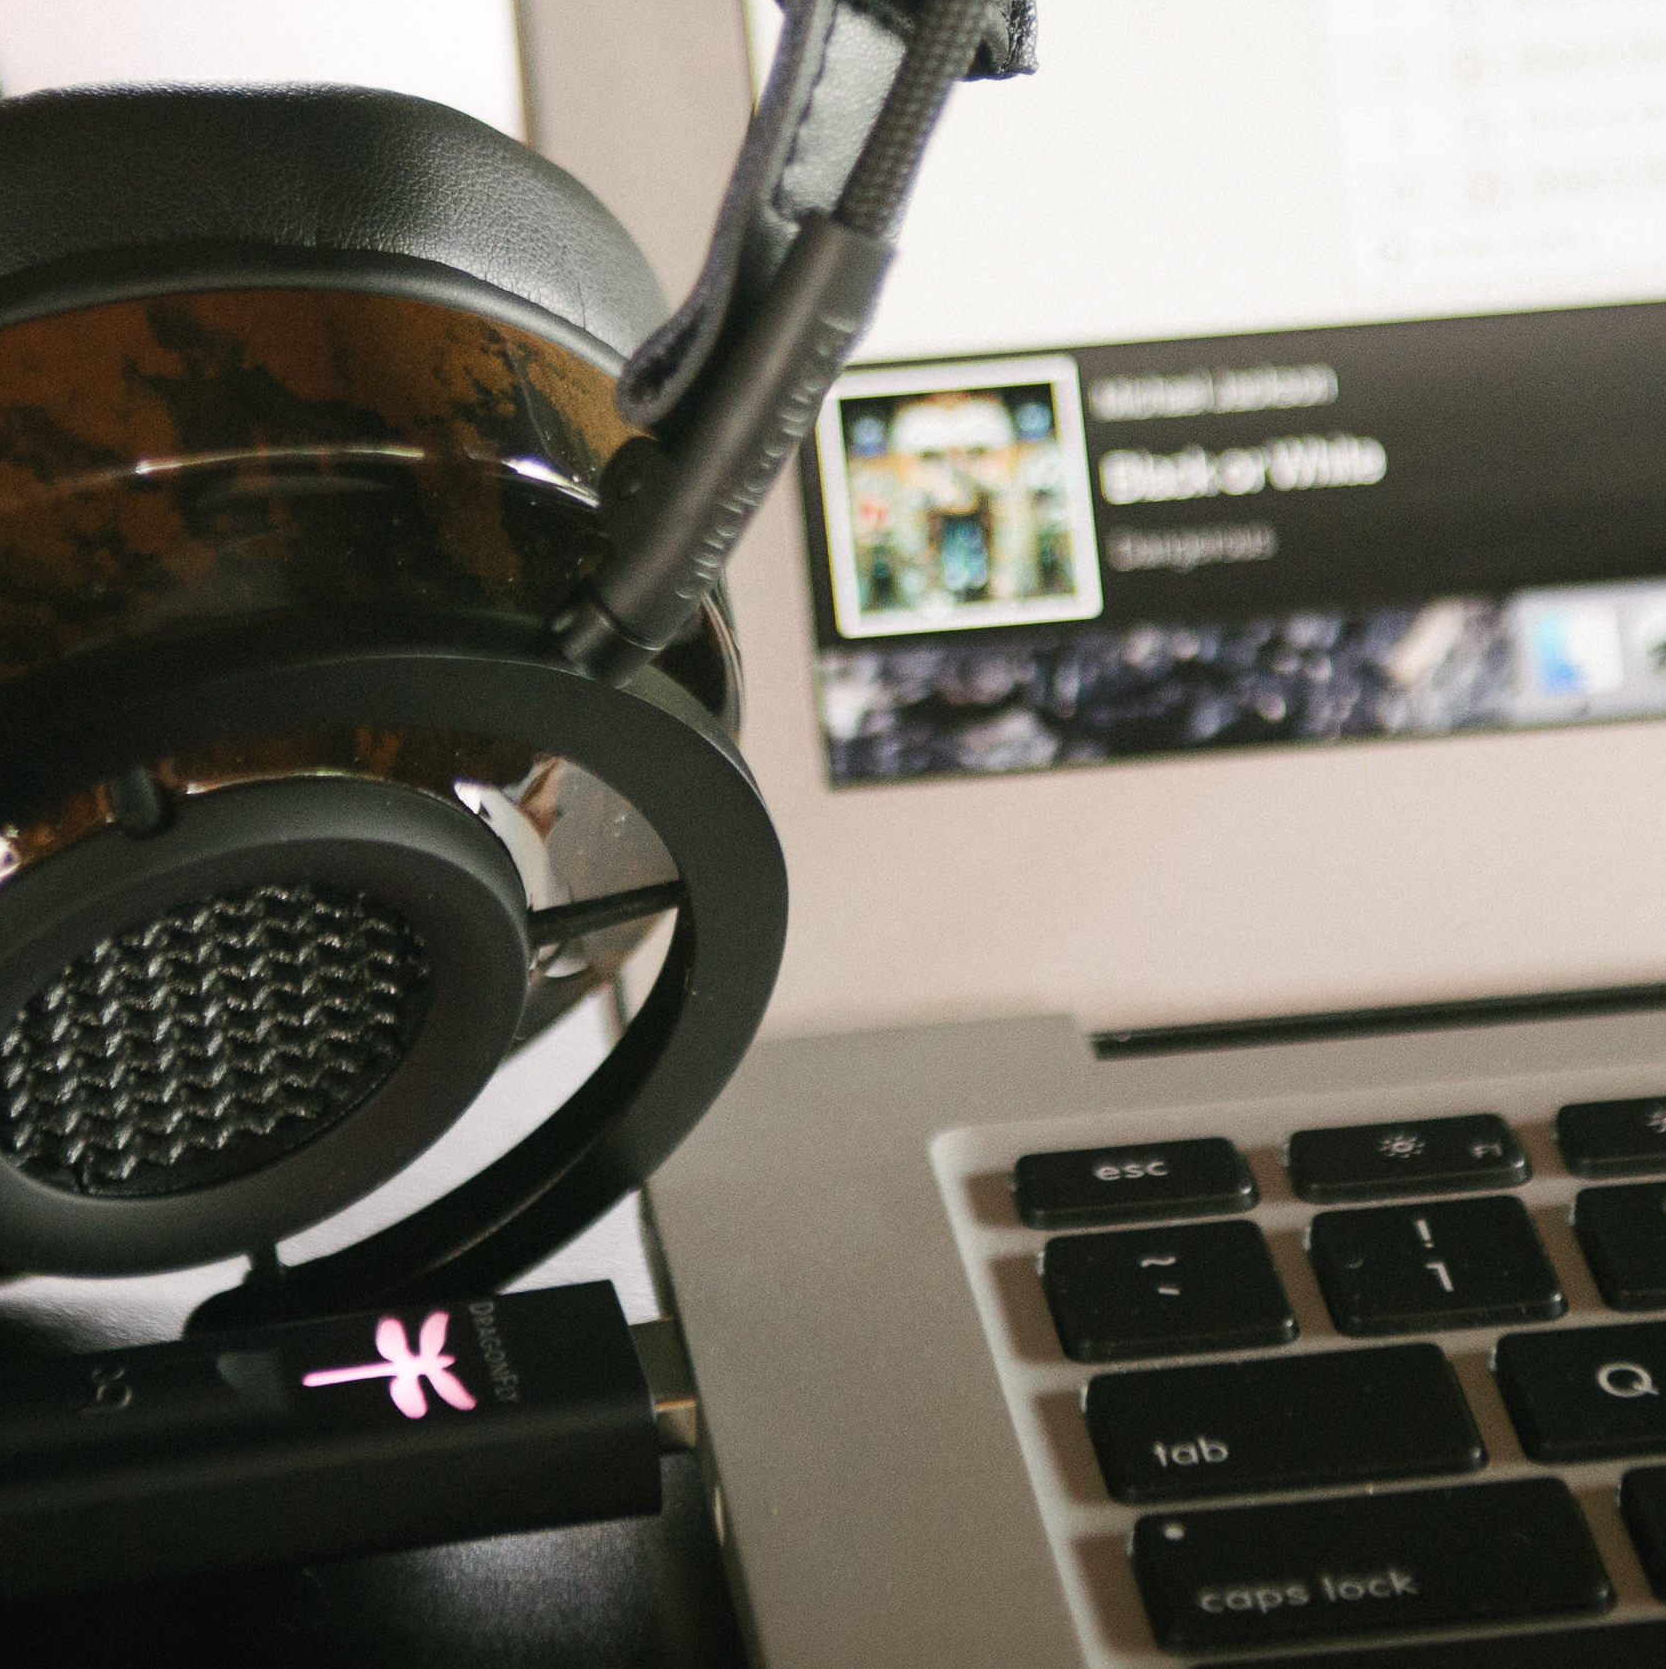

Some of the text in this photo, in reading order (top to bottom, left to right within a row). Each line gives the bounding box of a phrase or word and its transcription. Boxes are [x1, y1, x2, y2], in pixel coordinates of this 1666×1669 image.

[1093, 1159, 1167, 1182] esc
[1426, 1260, 1454, 1292] 1
[1595, 1362, 1658, 1398] Q
[1153, 1436, 1230, 1467] tab
[1198, 1568, 1415, 1614] caps lock
